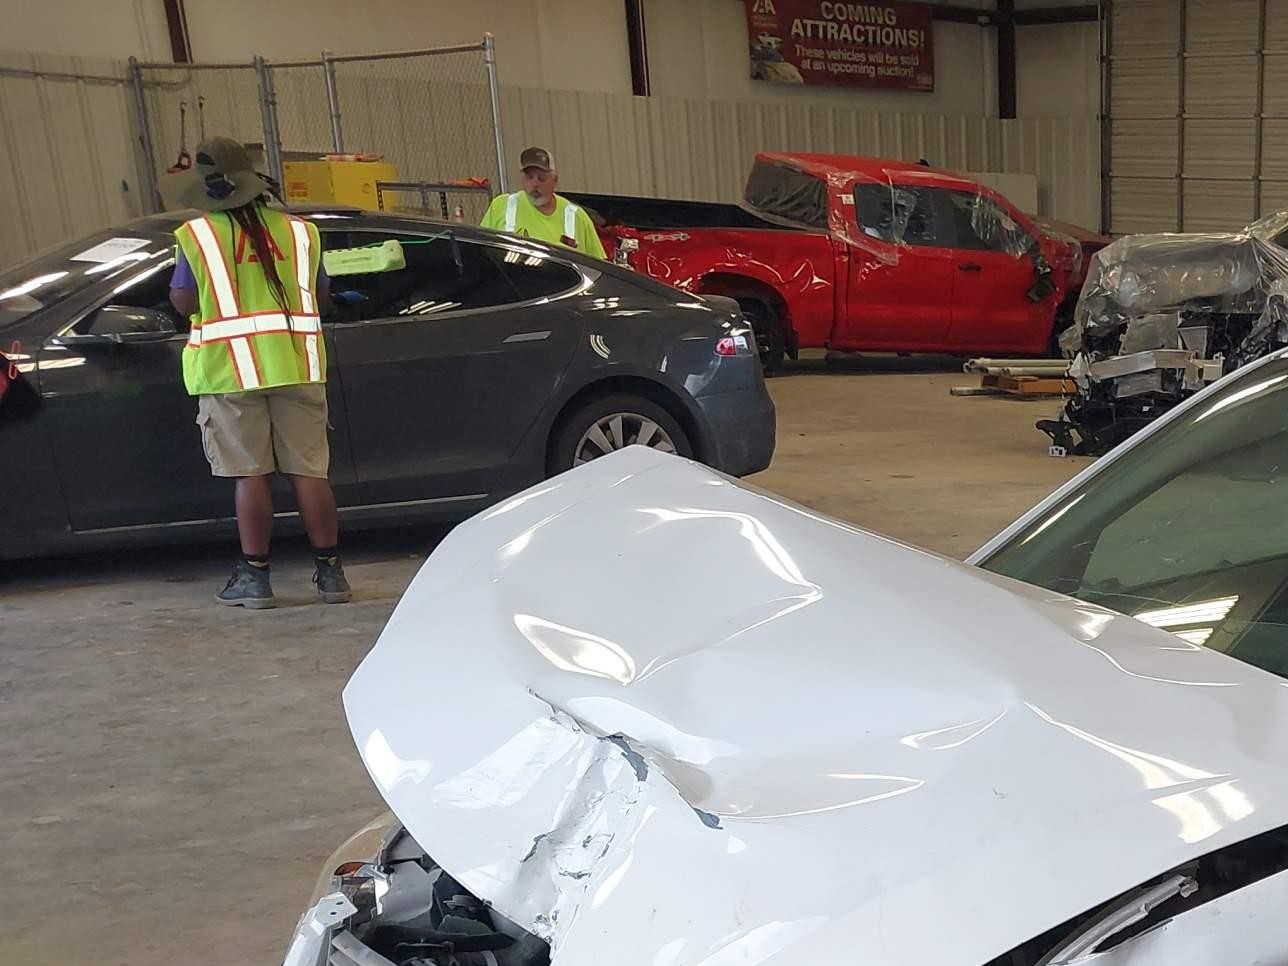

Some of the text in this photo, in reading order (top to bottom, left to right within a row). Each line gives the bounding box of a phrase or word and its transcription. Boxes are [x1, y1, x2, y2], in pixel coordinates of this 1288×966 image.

[820, 1, 897, 26] COMING
[791, 18, 925, 47] ATTRACTIONS!
[794, 44, 919, 66] These vehicles will be sold
[801, 59, 914, 78] at an upcoming auction!
